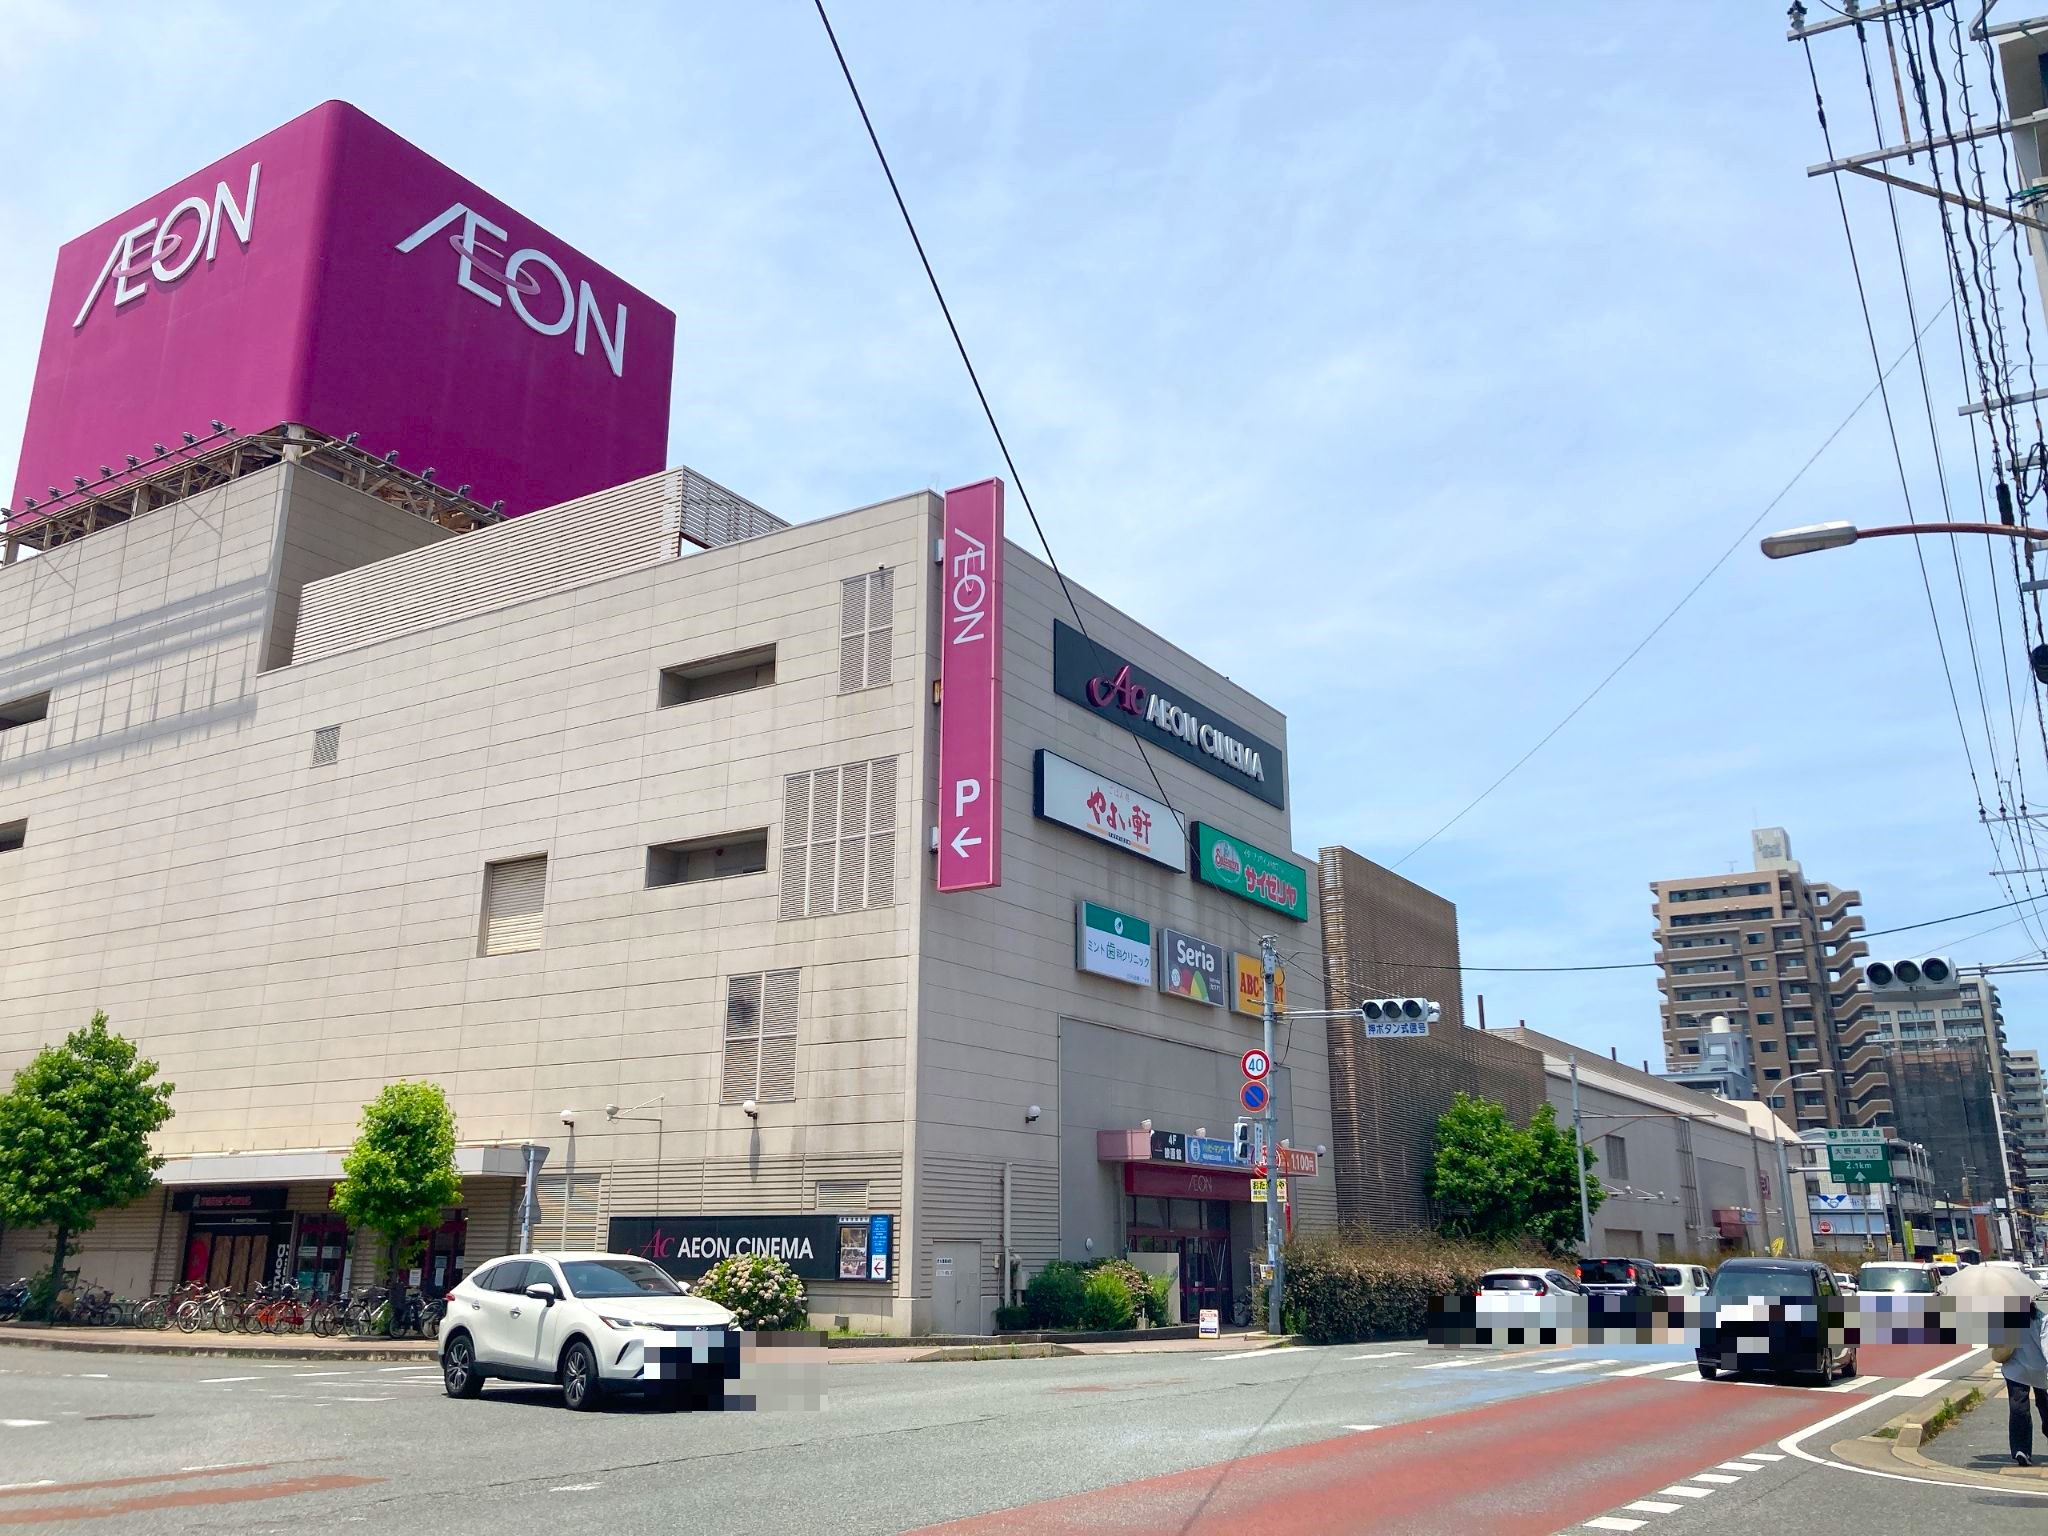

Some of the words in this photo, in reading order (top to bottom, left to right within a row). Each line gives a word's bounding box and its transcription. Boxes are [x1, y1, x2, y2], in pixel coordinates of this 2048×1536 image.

[1145, 693, 1199, 746] AEON
[1200, 724, 1265, 782] CINEMA
[956, 778, 981, 817] P
[1087, 786, 1152, 845] やよい軒
[1245, 864, 1297, 910] サイゼリヤ
[1088, 940, 1149, 968] ミント歯科クリニック
[1177, 940, 1215, 972] Seria
[1240, 972, 1284, 1003] ABC-RT
[1367, 1022, 1426, 1035] 押ボタン式信号
[1248, 1058, 1264, 1072] 40
[1846, 1161, 1872, 1169] 2.1km
[677, 1236, 730, 1259] AEON
[736, 1237, 814, 1259] CINEMA
